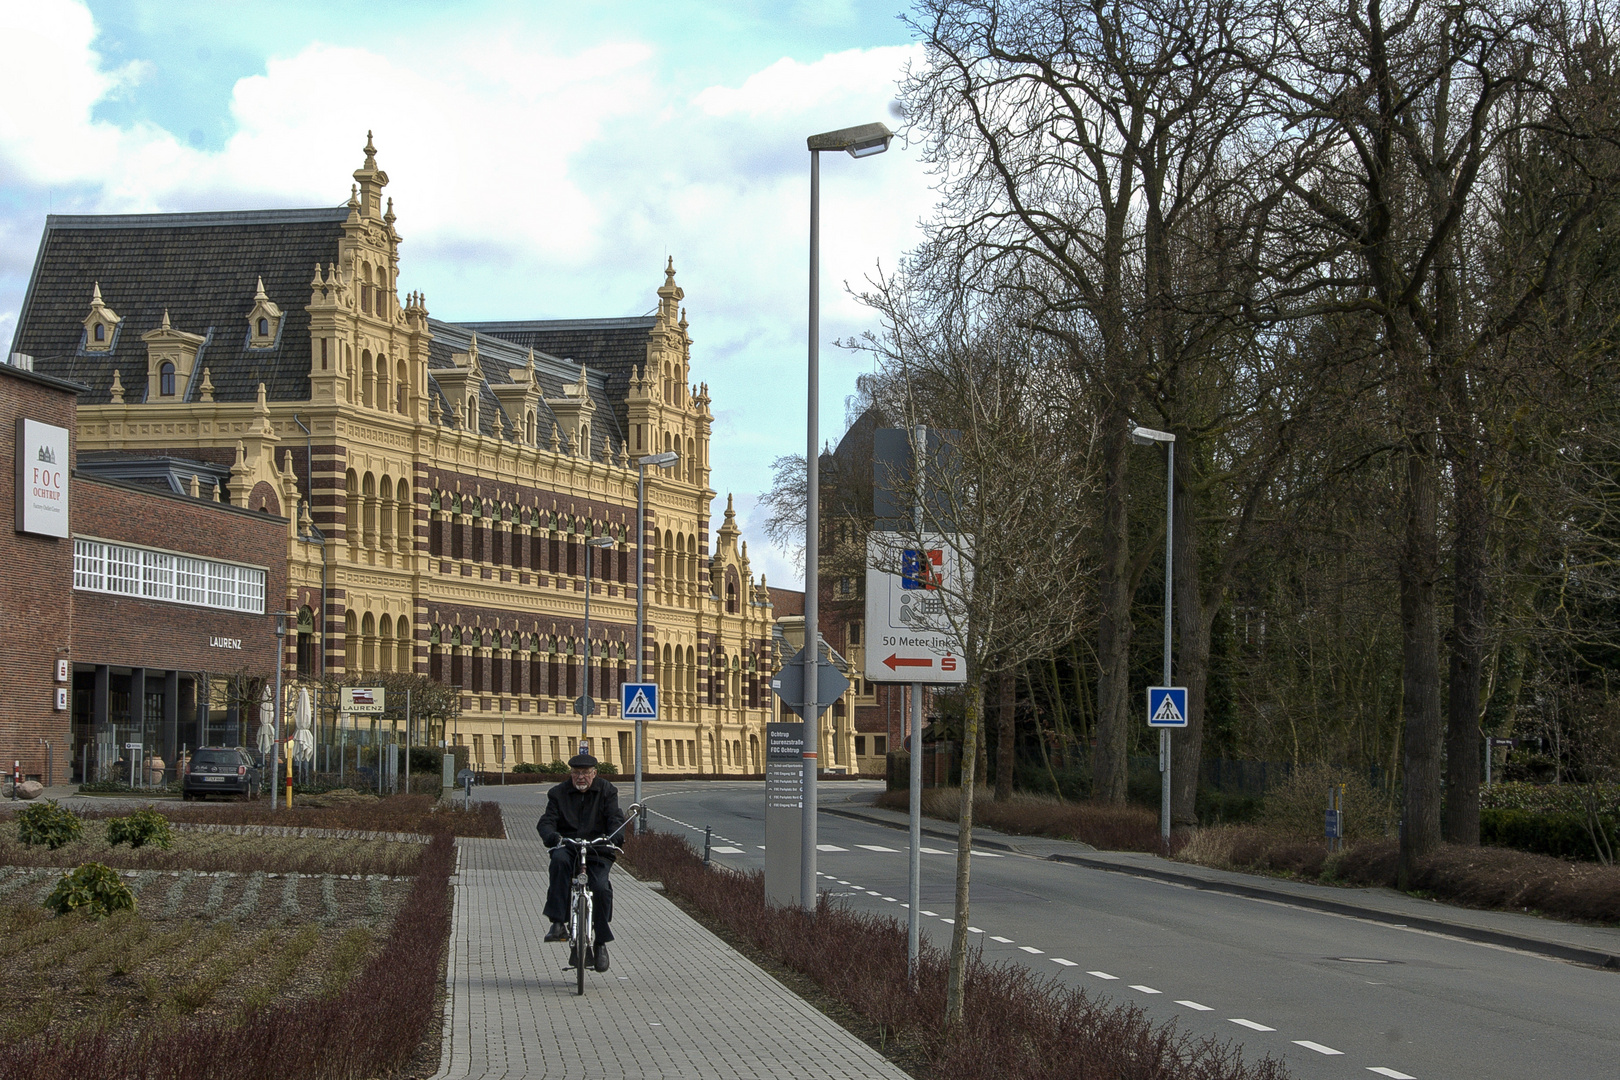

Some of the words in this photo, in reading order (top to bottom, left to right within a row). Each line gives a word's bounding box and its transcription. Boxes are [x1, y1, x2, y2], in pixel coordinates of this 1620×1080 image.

[33, 468, 61, 489] FOC
[33, 487, 61, 500] OCHTRUP
[209, 636, 242, 649] LAURENZ
[882, 636, 896, 646] 50
[899, 636, 930, 646] Meter
[932, 636, 957, 647] links
